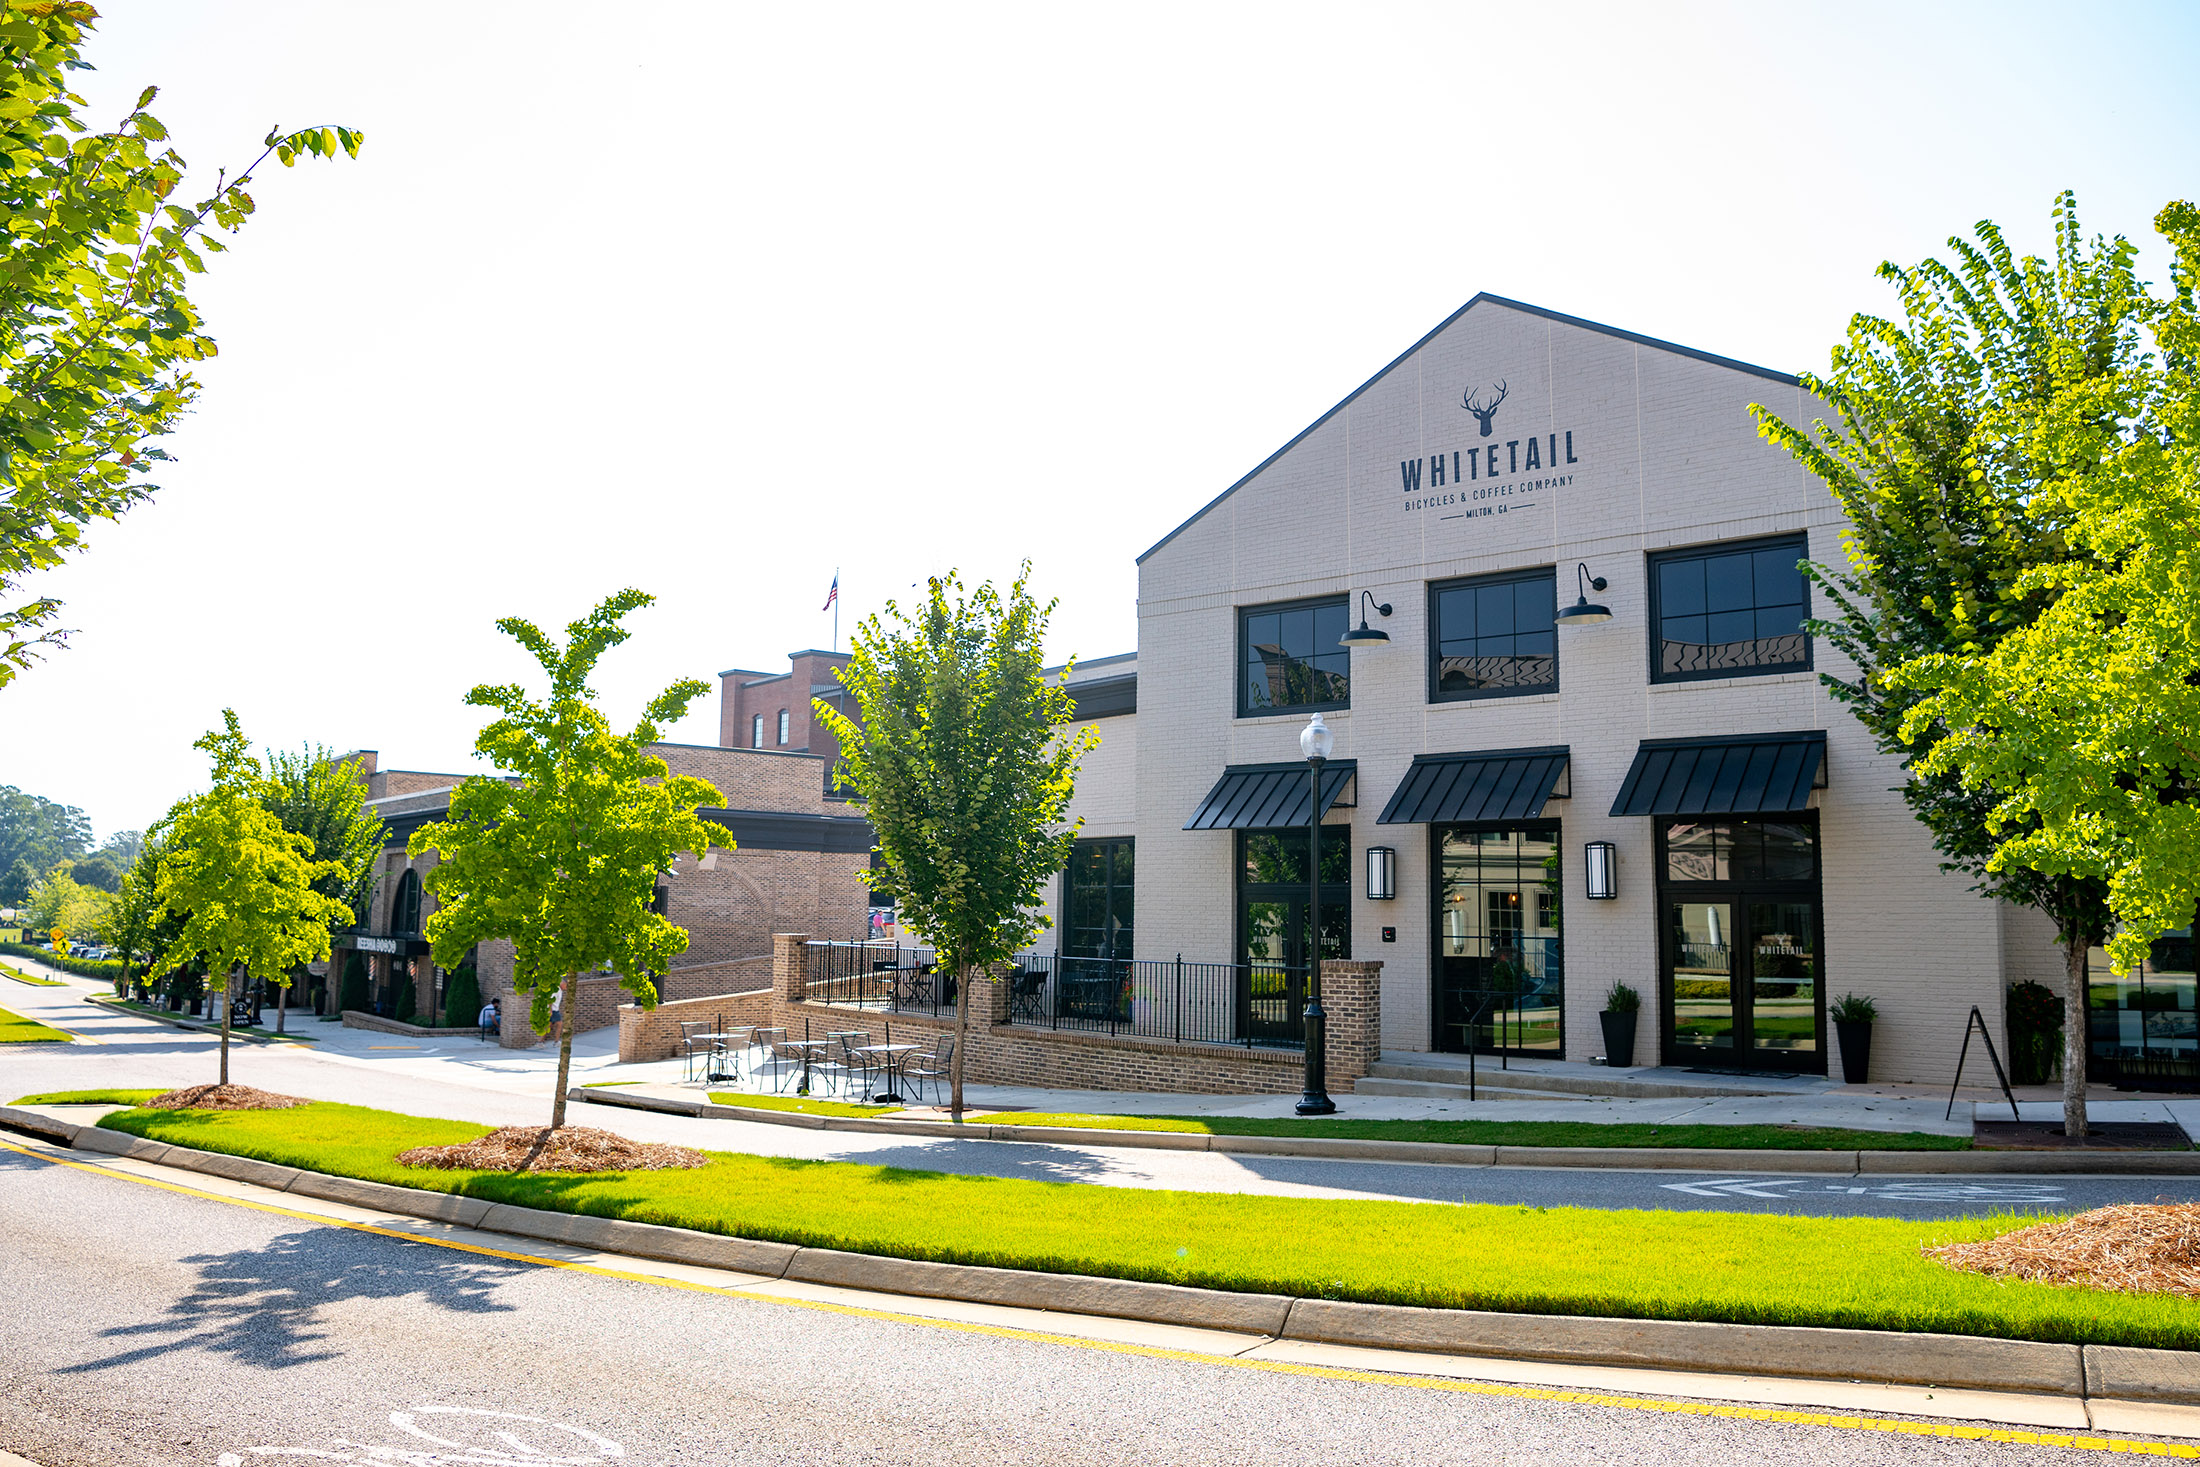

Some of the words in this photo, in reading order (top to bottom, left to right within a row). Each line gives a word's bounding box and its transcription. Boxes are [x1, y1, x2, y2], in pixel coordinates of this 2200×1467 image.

[1401, 431, 1577, 492] WHITETAIL
[1405, 494, 1455, 512] BICYCLES
[1460, 492, 1467, 502] &
[1473, 484, 1514, 500] COFFEE
[1519, 474, 1575, 493] COMPANY
[1498, 504, 1508, 514] GA
[1681, 944, 1724, 953] WHITETAIL
[1759, 946, 1804, 955] WHITETAIL
